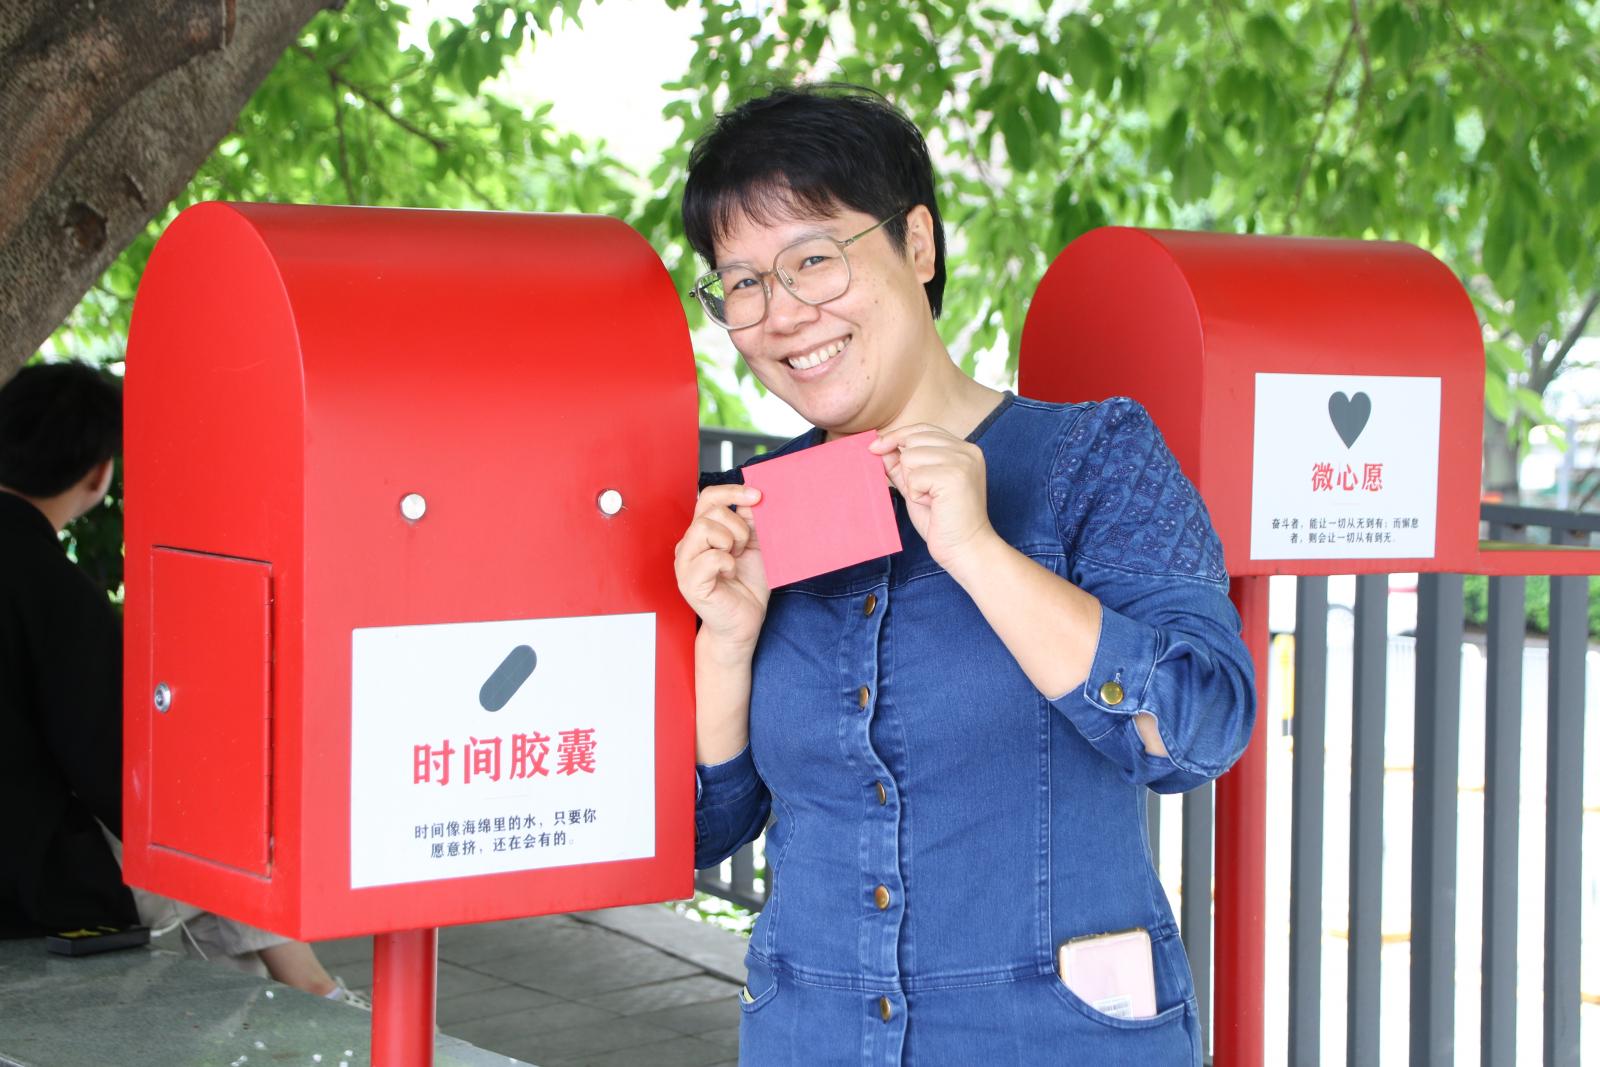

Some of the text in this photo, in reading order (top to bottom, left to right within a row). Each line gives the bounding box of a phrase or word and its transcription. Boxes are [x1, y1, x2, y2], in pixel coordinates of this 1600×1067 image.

[1311, 462, 1383, 492] 微心愿
[413, 728, 597, 786] 时间胶囊
[414, 808, 597, 840] 时间像海绵里的水，只要你
